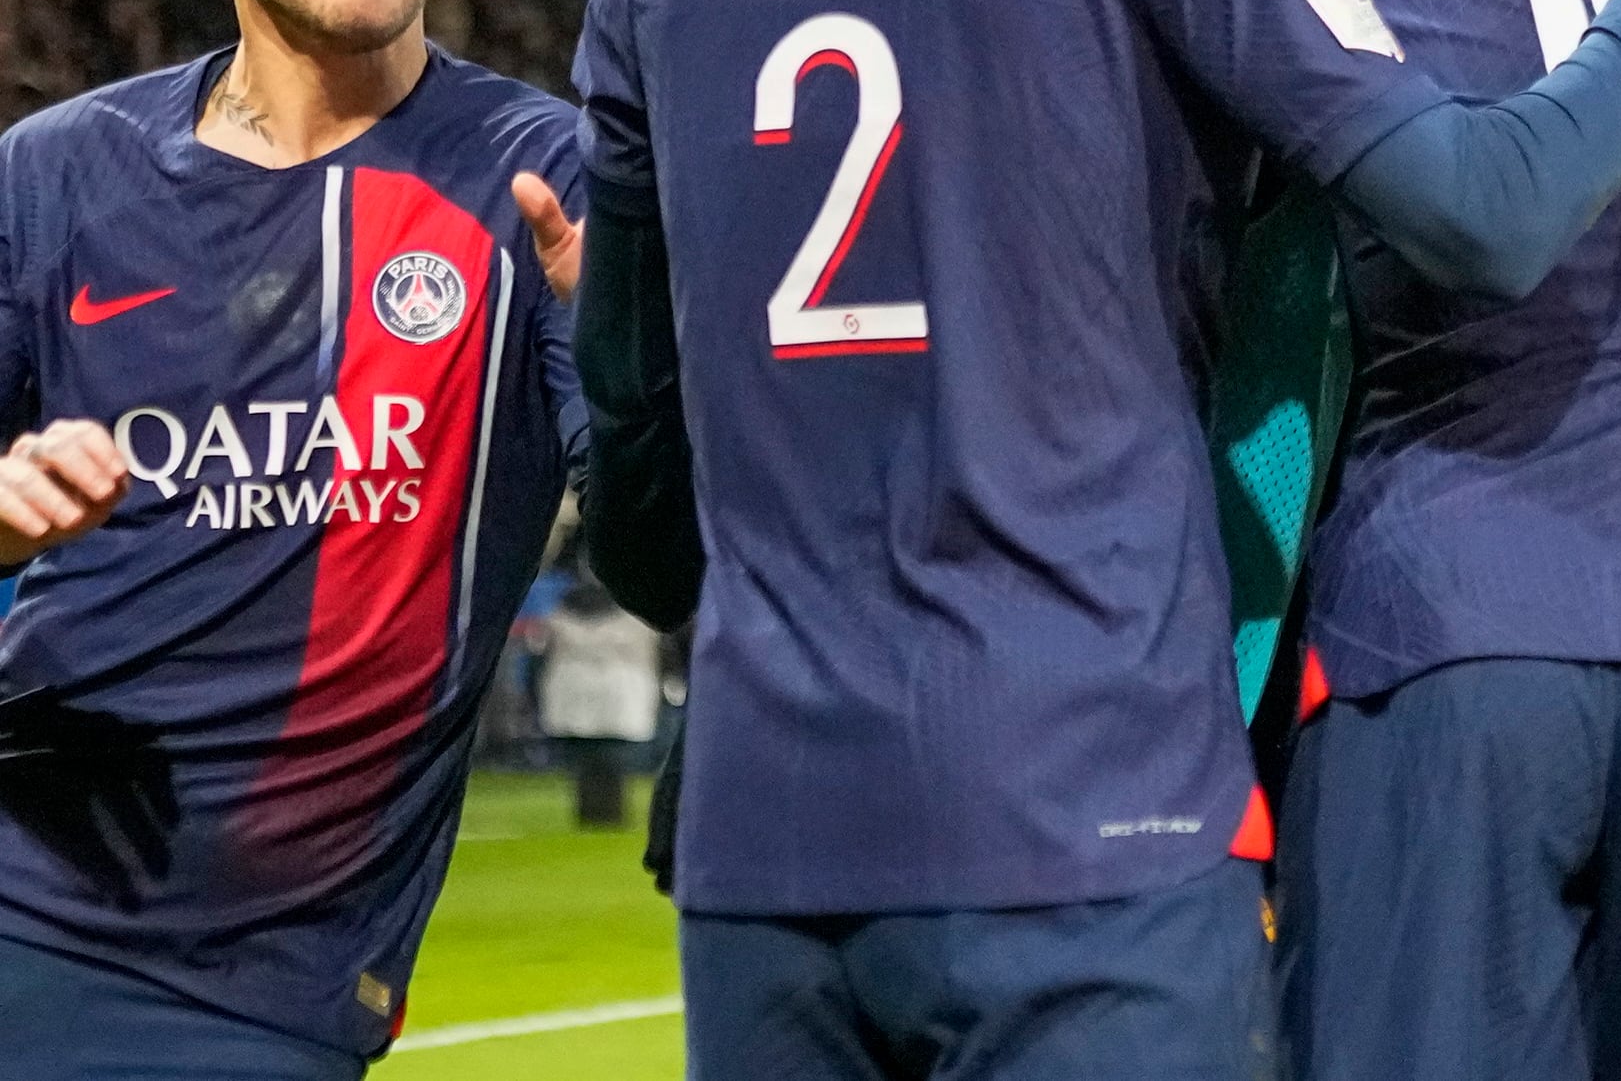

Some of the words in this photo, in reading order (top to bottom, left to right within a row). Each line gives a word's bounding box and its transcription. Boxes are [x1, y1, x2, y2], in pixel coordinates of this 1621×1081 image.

[753, 11, 930, 360] 2
[387, 256, 449, 280] PARIS
[113, 394, 426, 500] QATAR
[186, 476, 421, 530] AIRWAYS
